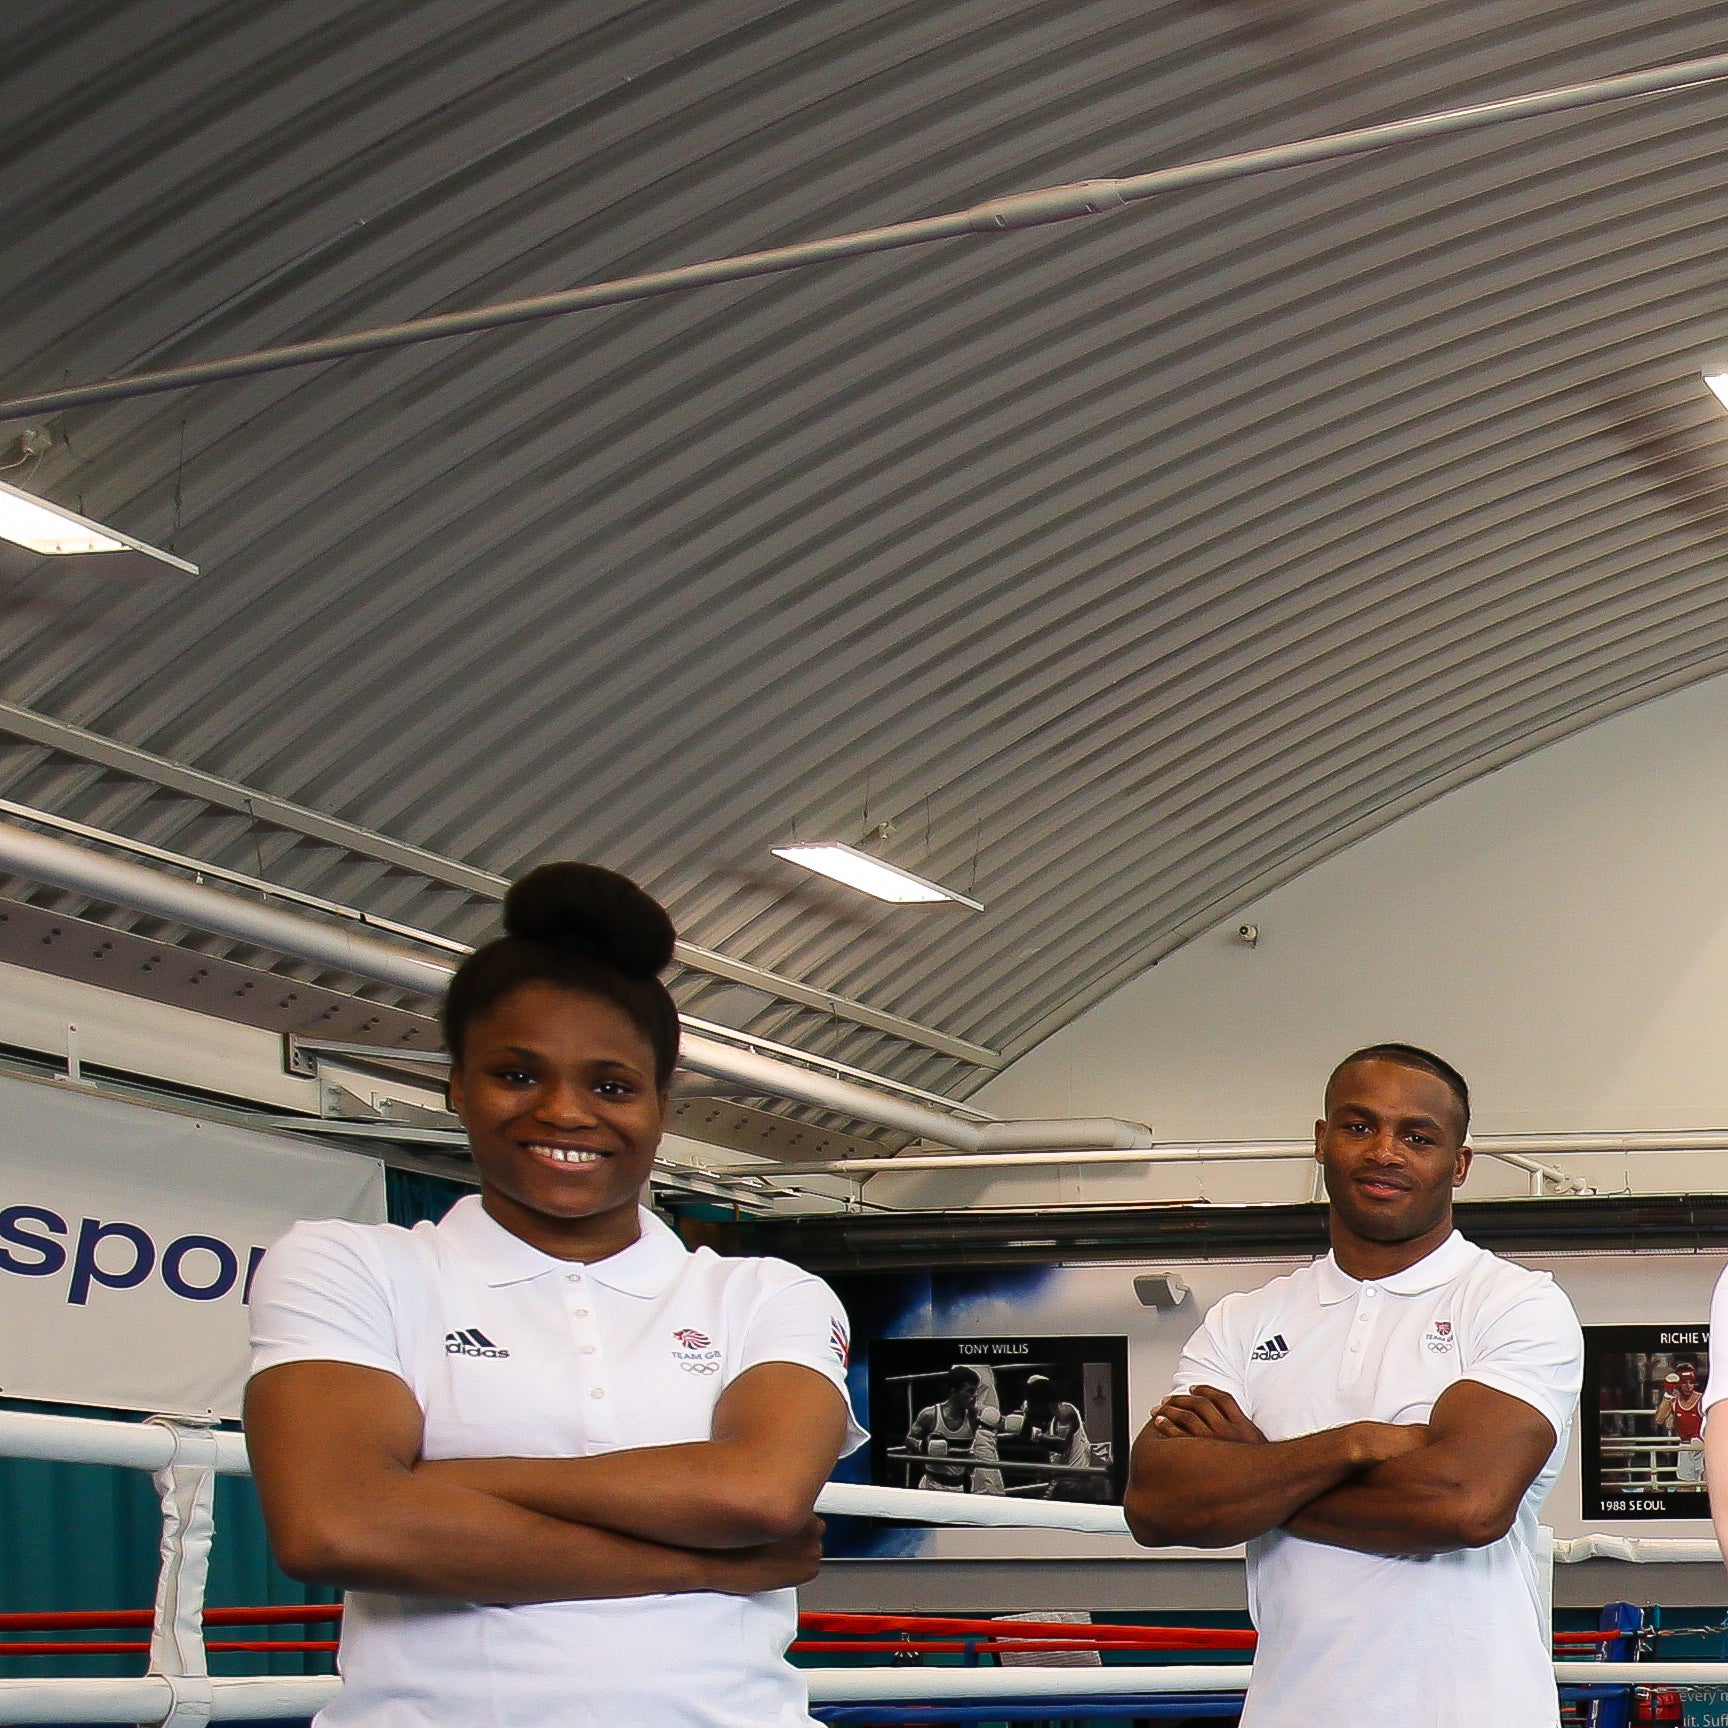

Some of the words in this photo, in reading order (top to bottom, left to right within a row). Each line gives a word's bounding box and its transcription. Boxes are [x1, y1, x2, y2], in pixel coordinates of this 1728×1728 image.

[1661, 1332, 1700, 1344] RICHIE
[671, 1351, 704, 1360] TEAM
[704, 1350, 722, 1360] GB
[958, 1344, 990, 1355] TONY
[992, 1343, 1029, 1355] WILLIS
[1600, 1501, 1626, 1512] 1988
[1628, 1500, 1666, 1512] SEOUL
[1679, 1691, 1717, 1705] every
